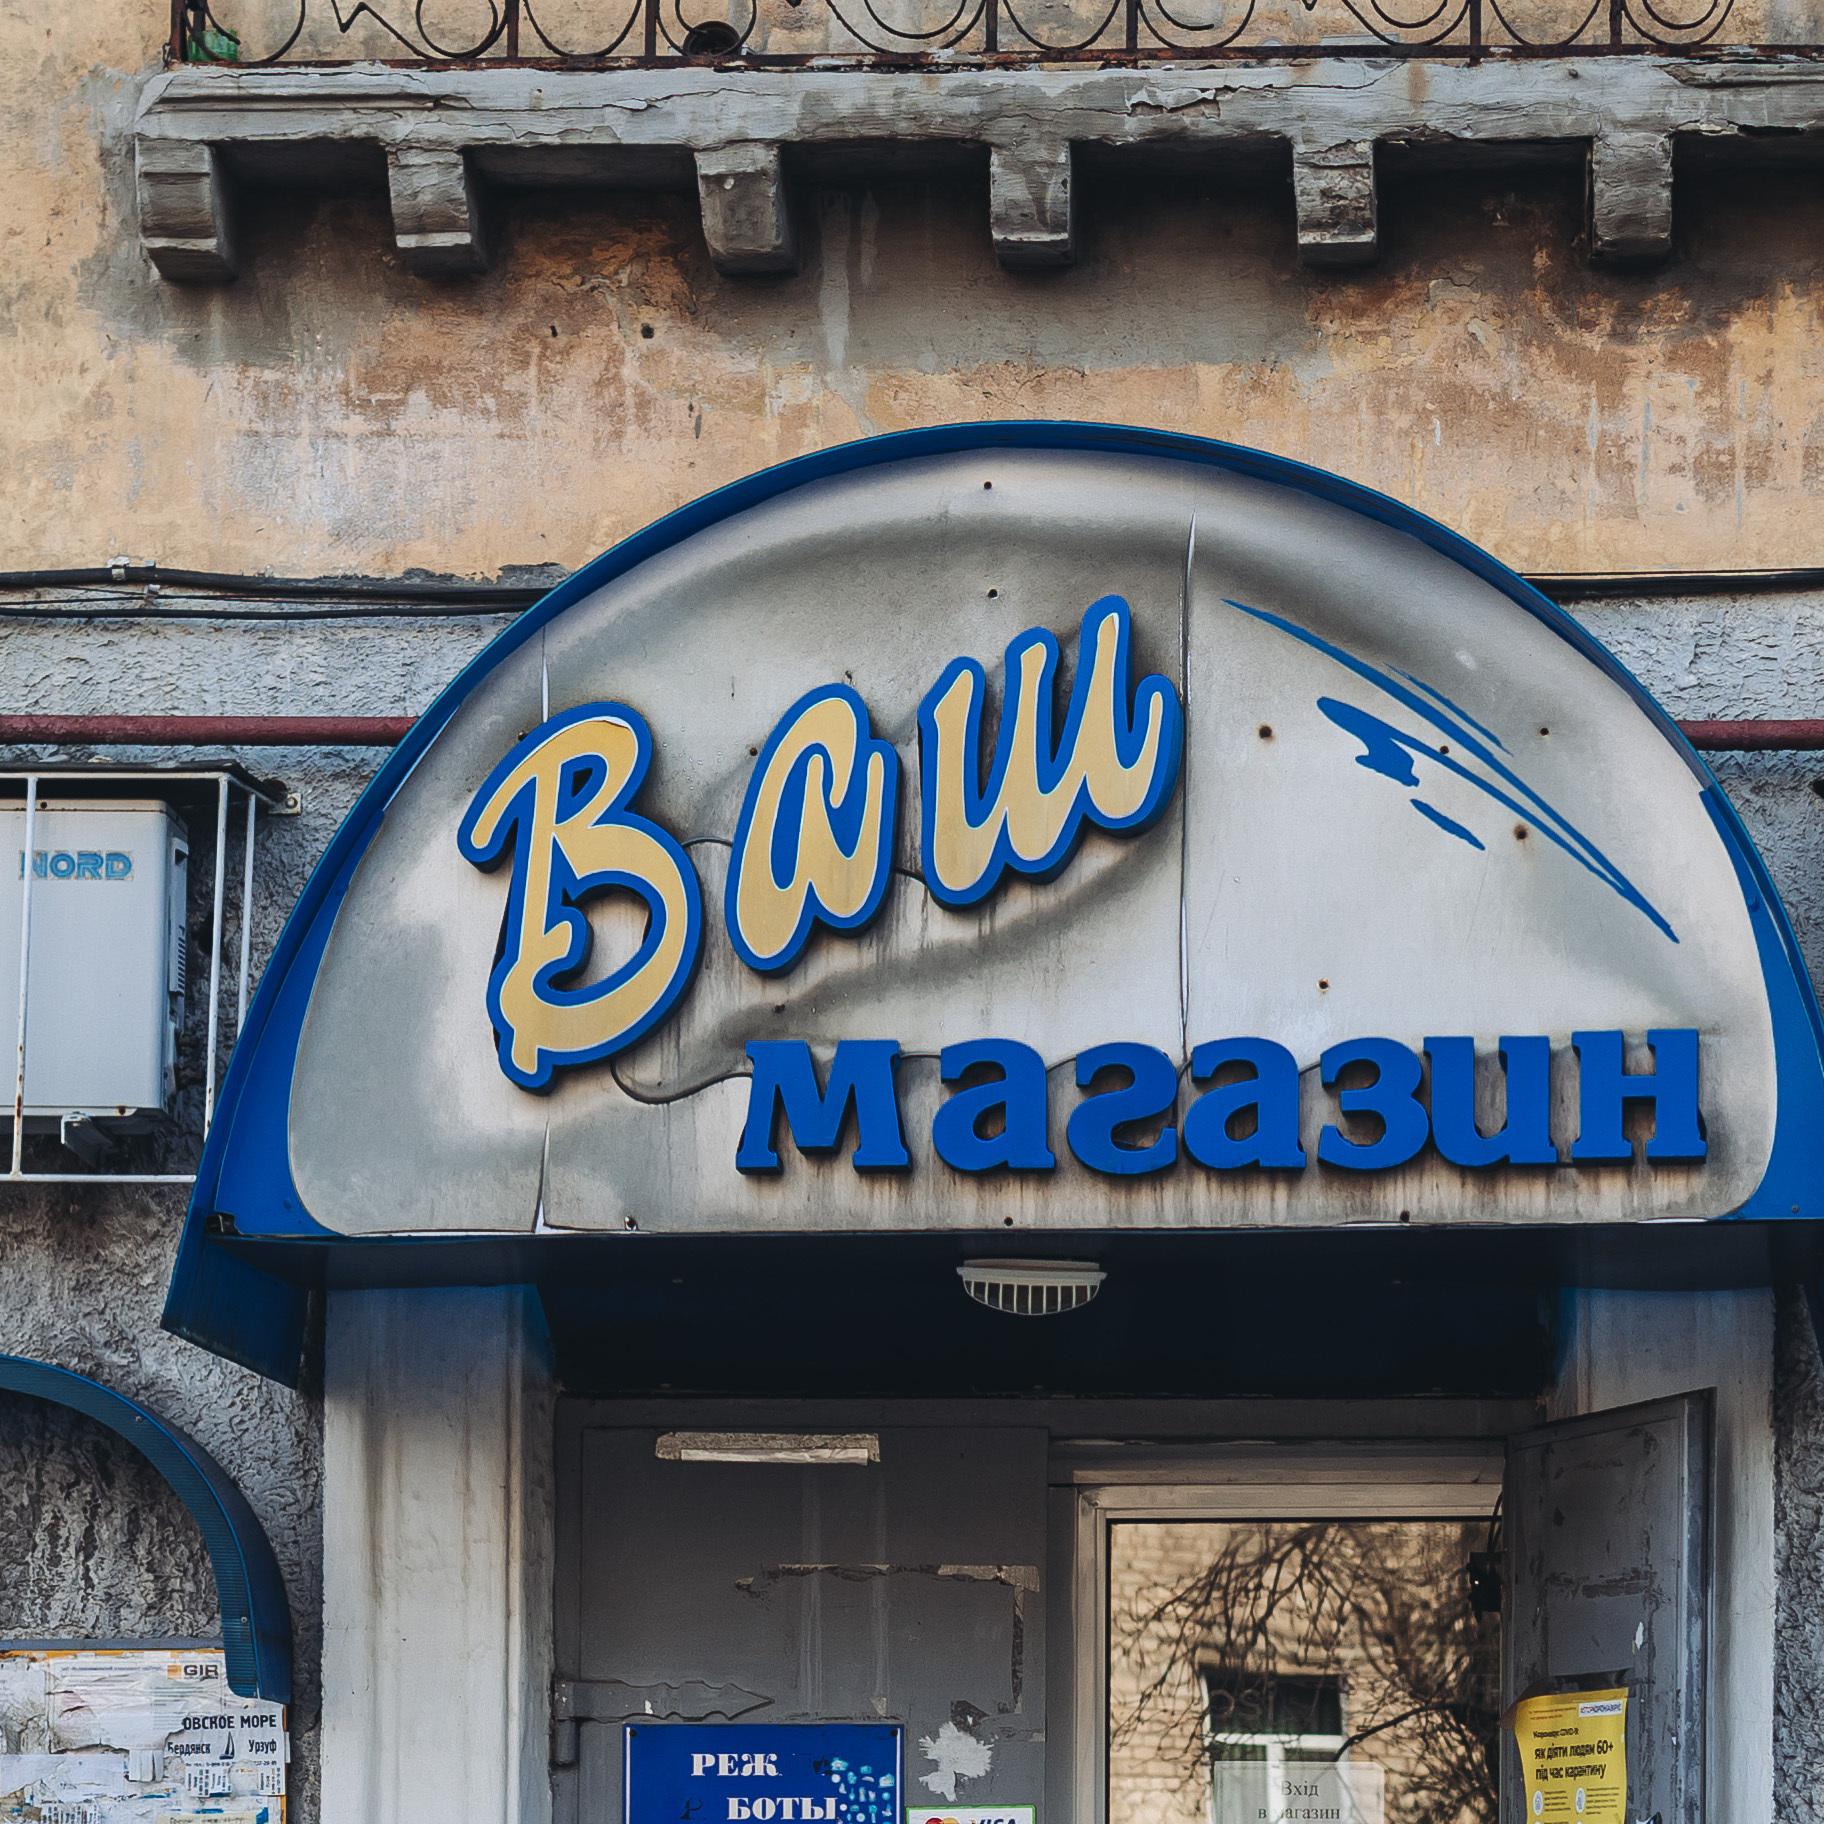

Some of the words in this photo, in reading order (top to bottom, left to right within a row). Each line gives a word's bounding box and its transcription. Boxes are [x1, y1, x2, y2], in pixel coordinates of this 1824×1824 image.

[456, 594, 1182, 1092] Ваш
[20, 851, 133, 880] NORD
[736, 1027, 1709, 1177] магазин
[181, 1715, 235, 1731] ОВСКОЕ
[240, 1714, 277, 1729] МОРЕ
[248, 1739, 277, 1755] Урзуф
[1596, 1739, 1614, 1755] 60+
[1535, 1763, 1549, 1782] під
[1549, 1767, 1564, 1779] час
[1564, 1763, 1607, 1780] карантину
[1281, 1780, 1320, 1797] Вхід
[1257, 1808, 1267, 1819] в
[1271, 1807, 1341, 1820] агазин
